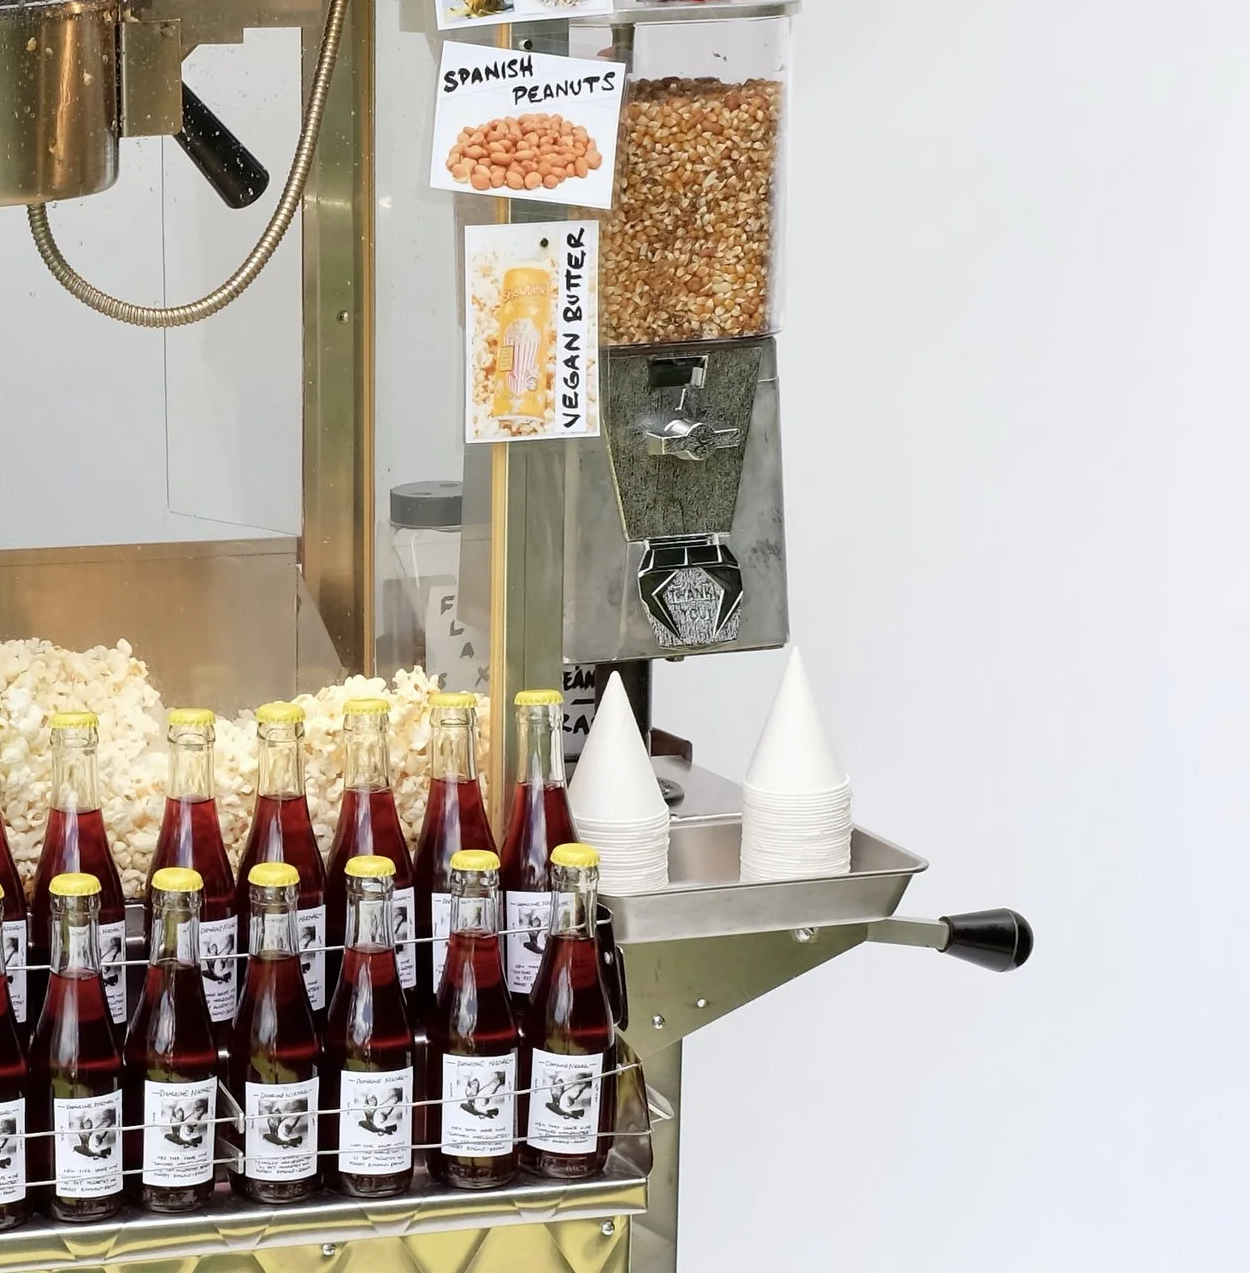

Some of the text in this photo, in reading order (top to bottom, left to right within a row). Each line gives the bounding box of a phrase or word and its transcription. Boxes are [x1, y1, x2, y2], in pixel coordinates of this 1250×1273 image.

[442, 54, 534, 93] SPANISH
[512, 71, 616, 105] PEANUTS
[562, 227, 587, 429] VEGAN BUTTER
